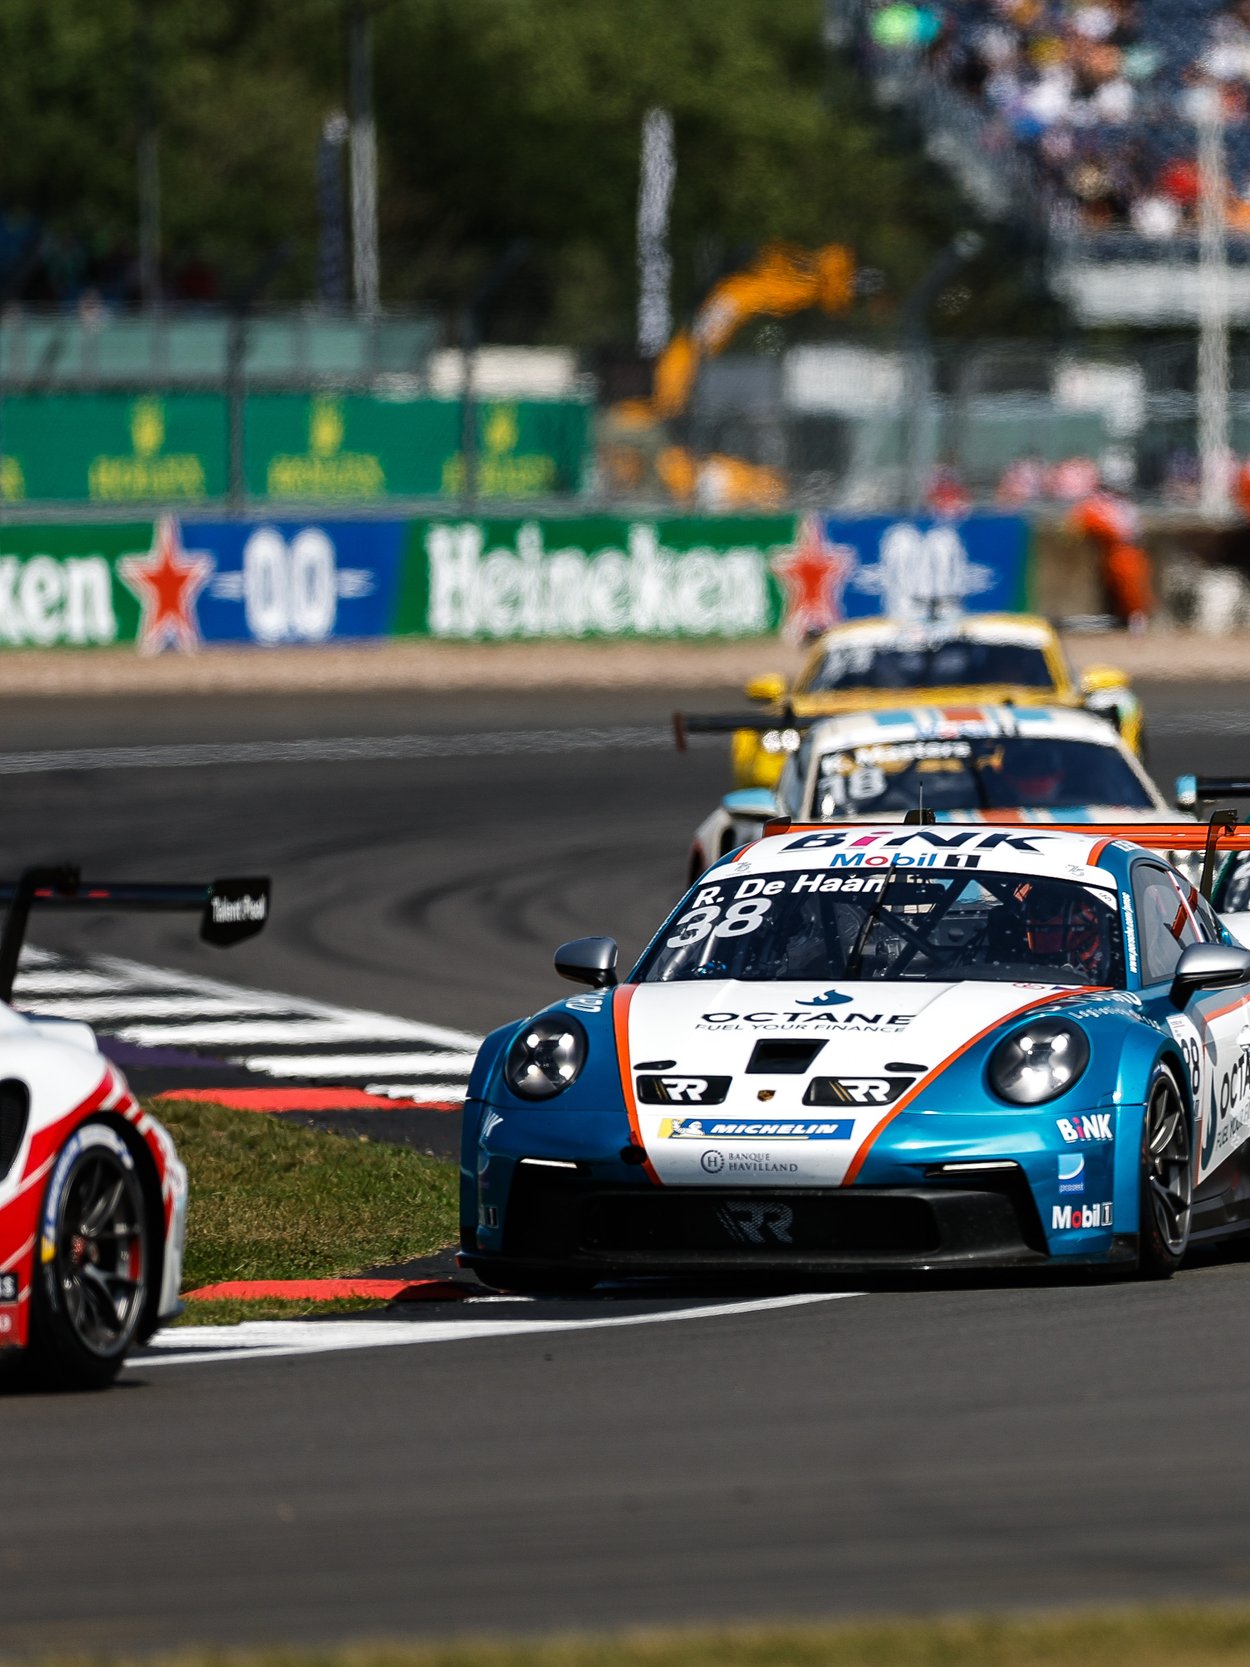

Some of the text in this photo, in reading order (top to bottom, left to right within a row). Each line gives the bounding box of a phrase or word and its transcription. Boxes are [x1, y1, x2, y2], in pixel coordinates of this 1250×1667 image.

[425, 521, 771, 637] Heineken
[829, 853, 977, 868] Mobil 1
[692, 873, 886, 909] R. De Haan
[666, 897, 772, 949] 38
[701, 1012, 918, 1025] OCTANE
[695, 1023, 907, 1033] FUEL YOUR FINANCE
[710, 1124, 839, 1135] MICHELIN
[728, 1152, 771, 1162] BANQUE
[728, 1162, 798, 1173] HAVILLAND
[1052, 1203, 1112, 1229] Mobil 1
